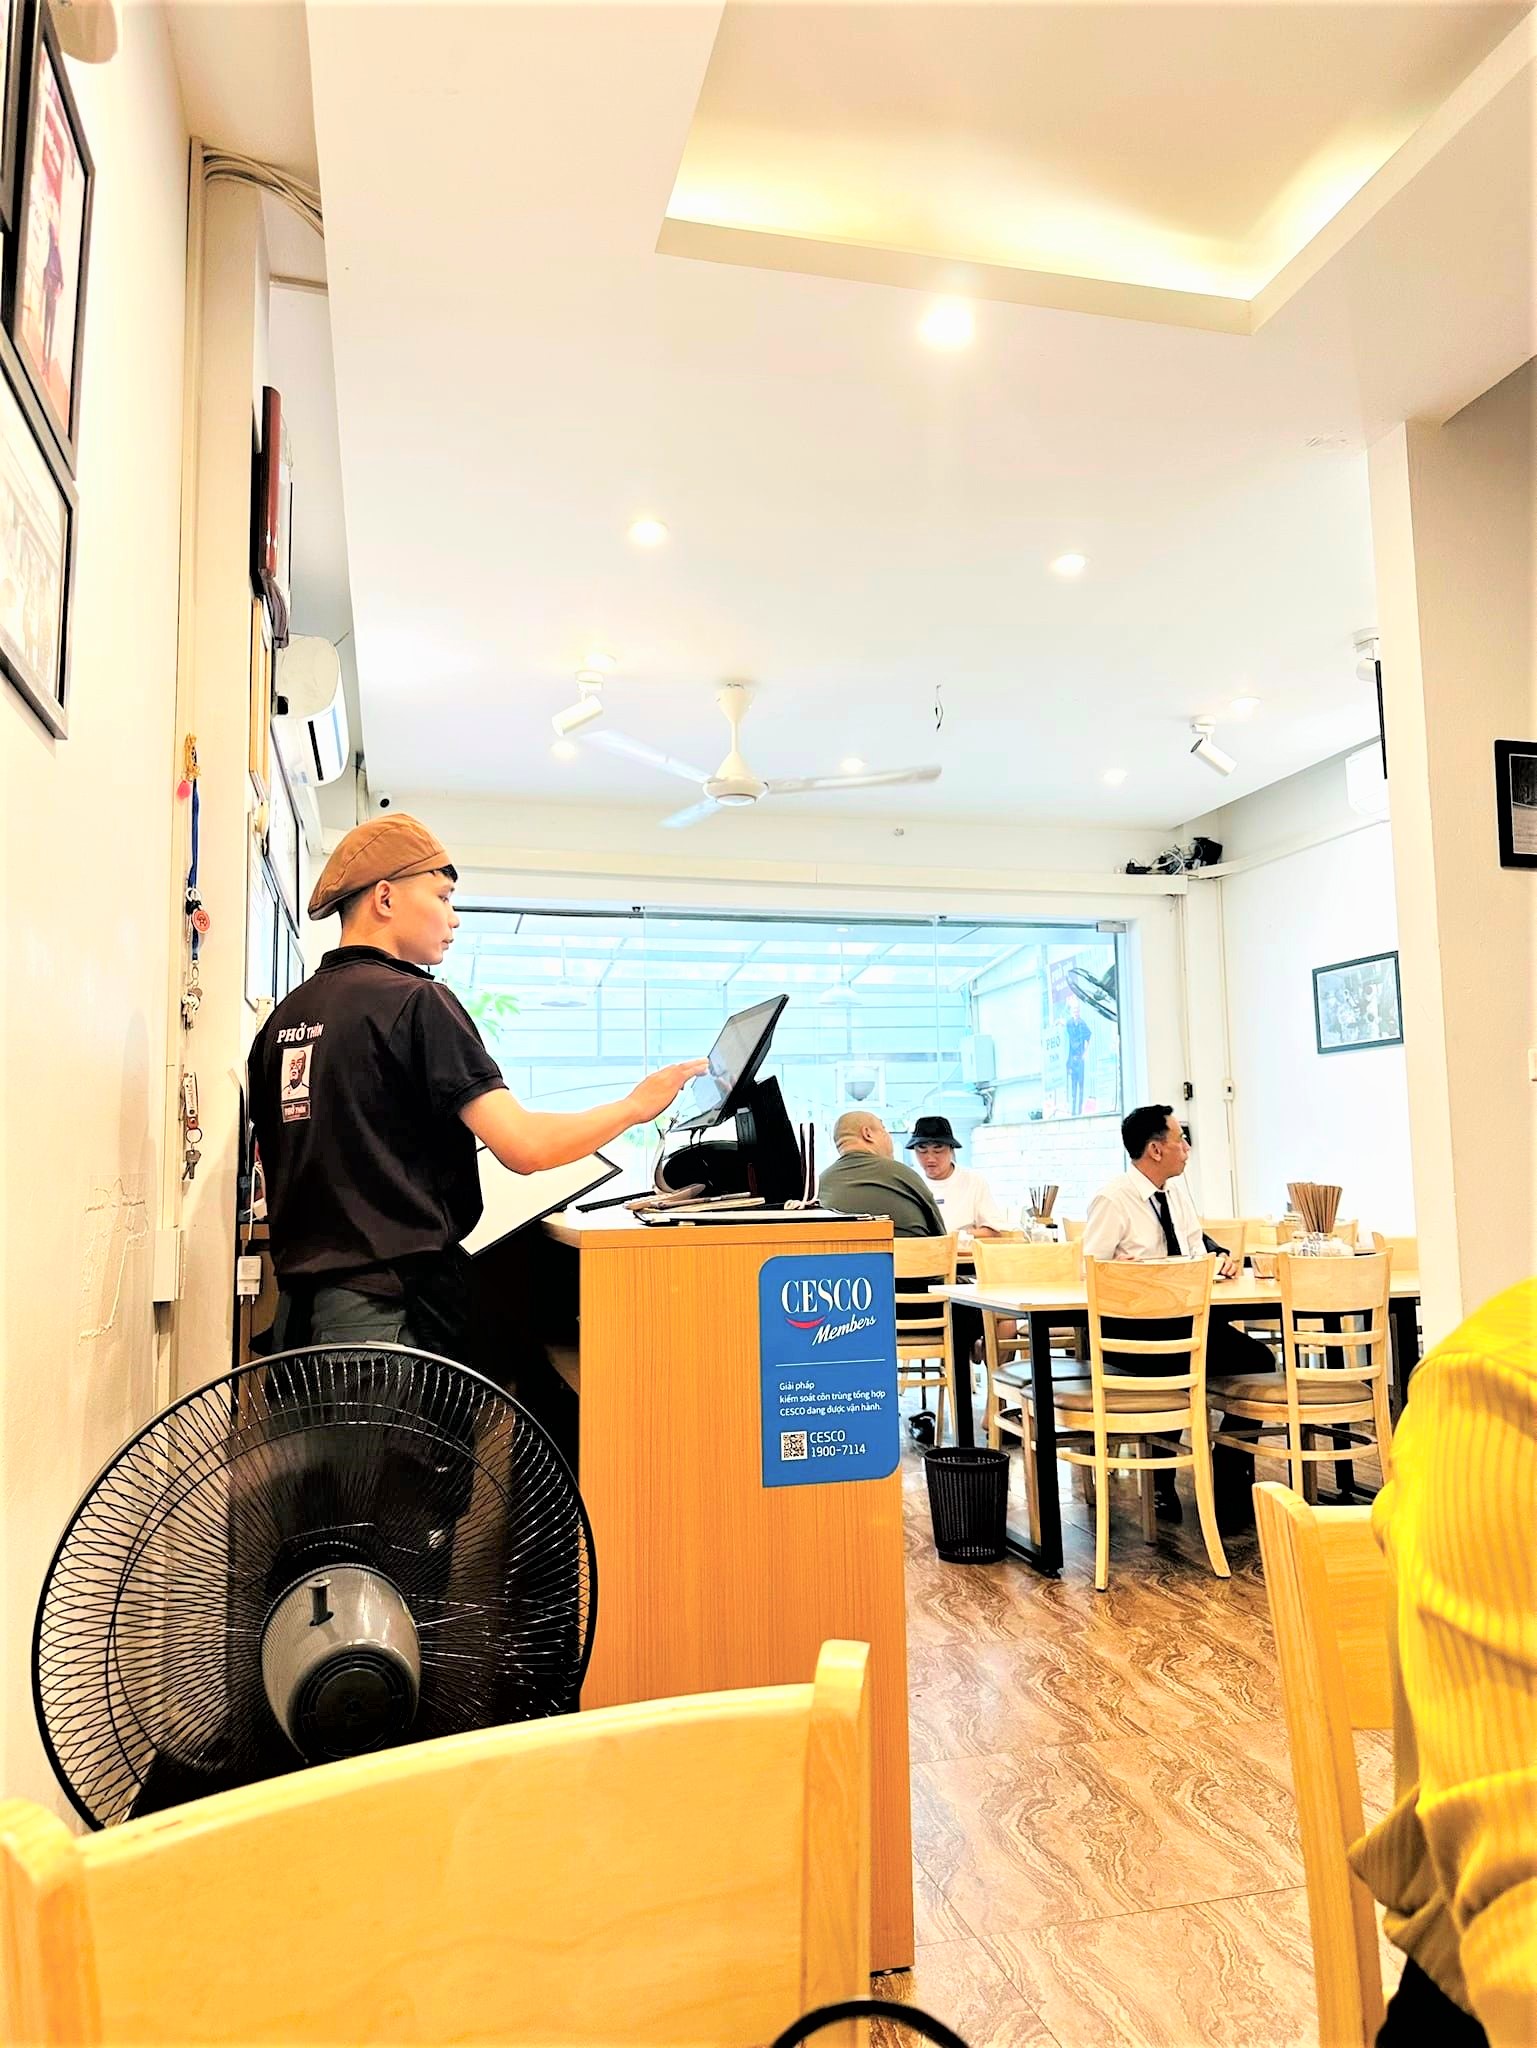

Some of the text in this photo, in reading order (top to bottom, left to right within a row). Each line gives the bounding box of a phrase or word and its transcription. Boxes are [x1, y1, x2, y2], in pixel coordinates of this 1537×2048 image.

[276, 1022, 306, 1043] PHỞ
[781, 1277, 872, 1313] CESCO
[811, 1313, 877, 1346] Members
[779, 1380, 815, 1391] Giải pháp
[799, 1393, 816, 1402] soát
[831, 1391, 852, 1401] trùng
[871, 1389, 886, 1399] hợp
[779, 1406, 806, 1416] CESCO
[809, 1429, 846, 1444] CESCO
[811, 1443, 866, 1458] 1900-7114
